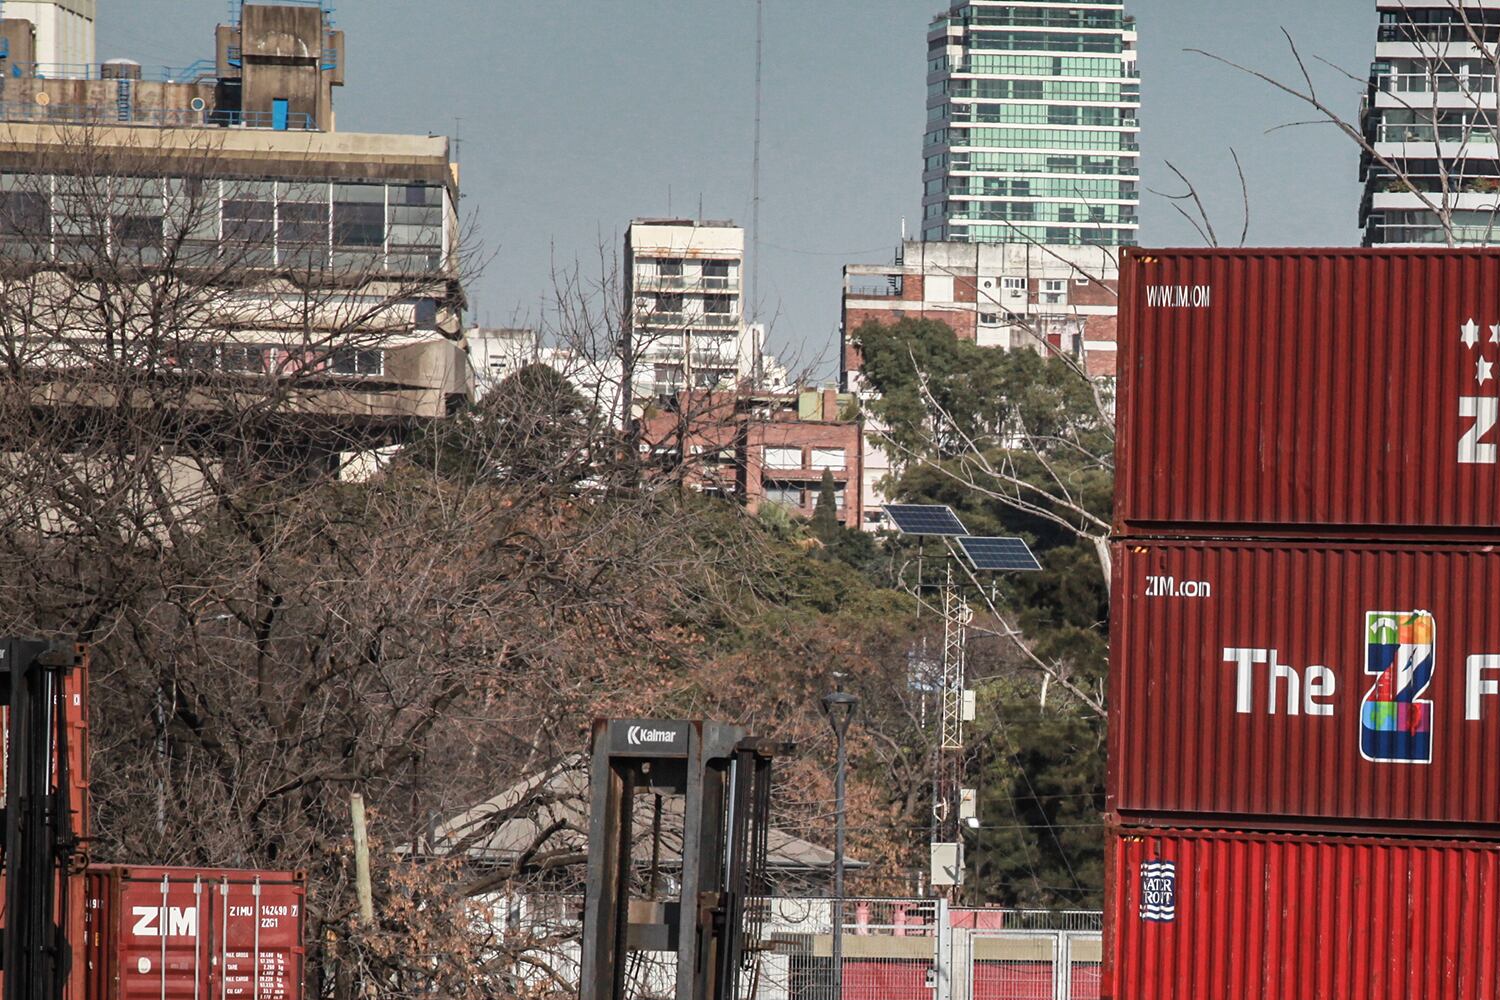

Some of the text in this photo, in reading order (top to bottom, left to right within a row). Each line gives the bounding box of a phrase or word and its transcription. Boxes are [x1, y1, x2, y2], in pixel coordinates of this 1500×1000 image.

[1223, 647, 1336, 716] The
[640, 727, 677, 743] Kalmar
[229, 906, 253, 917] ZIMU
[261, 905, 288, 916] 142490
[132, 906, 197, 936] ZIM
[261, 918, 279, 928] 22G1
